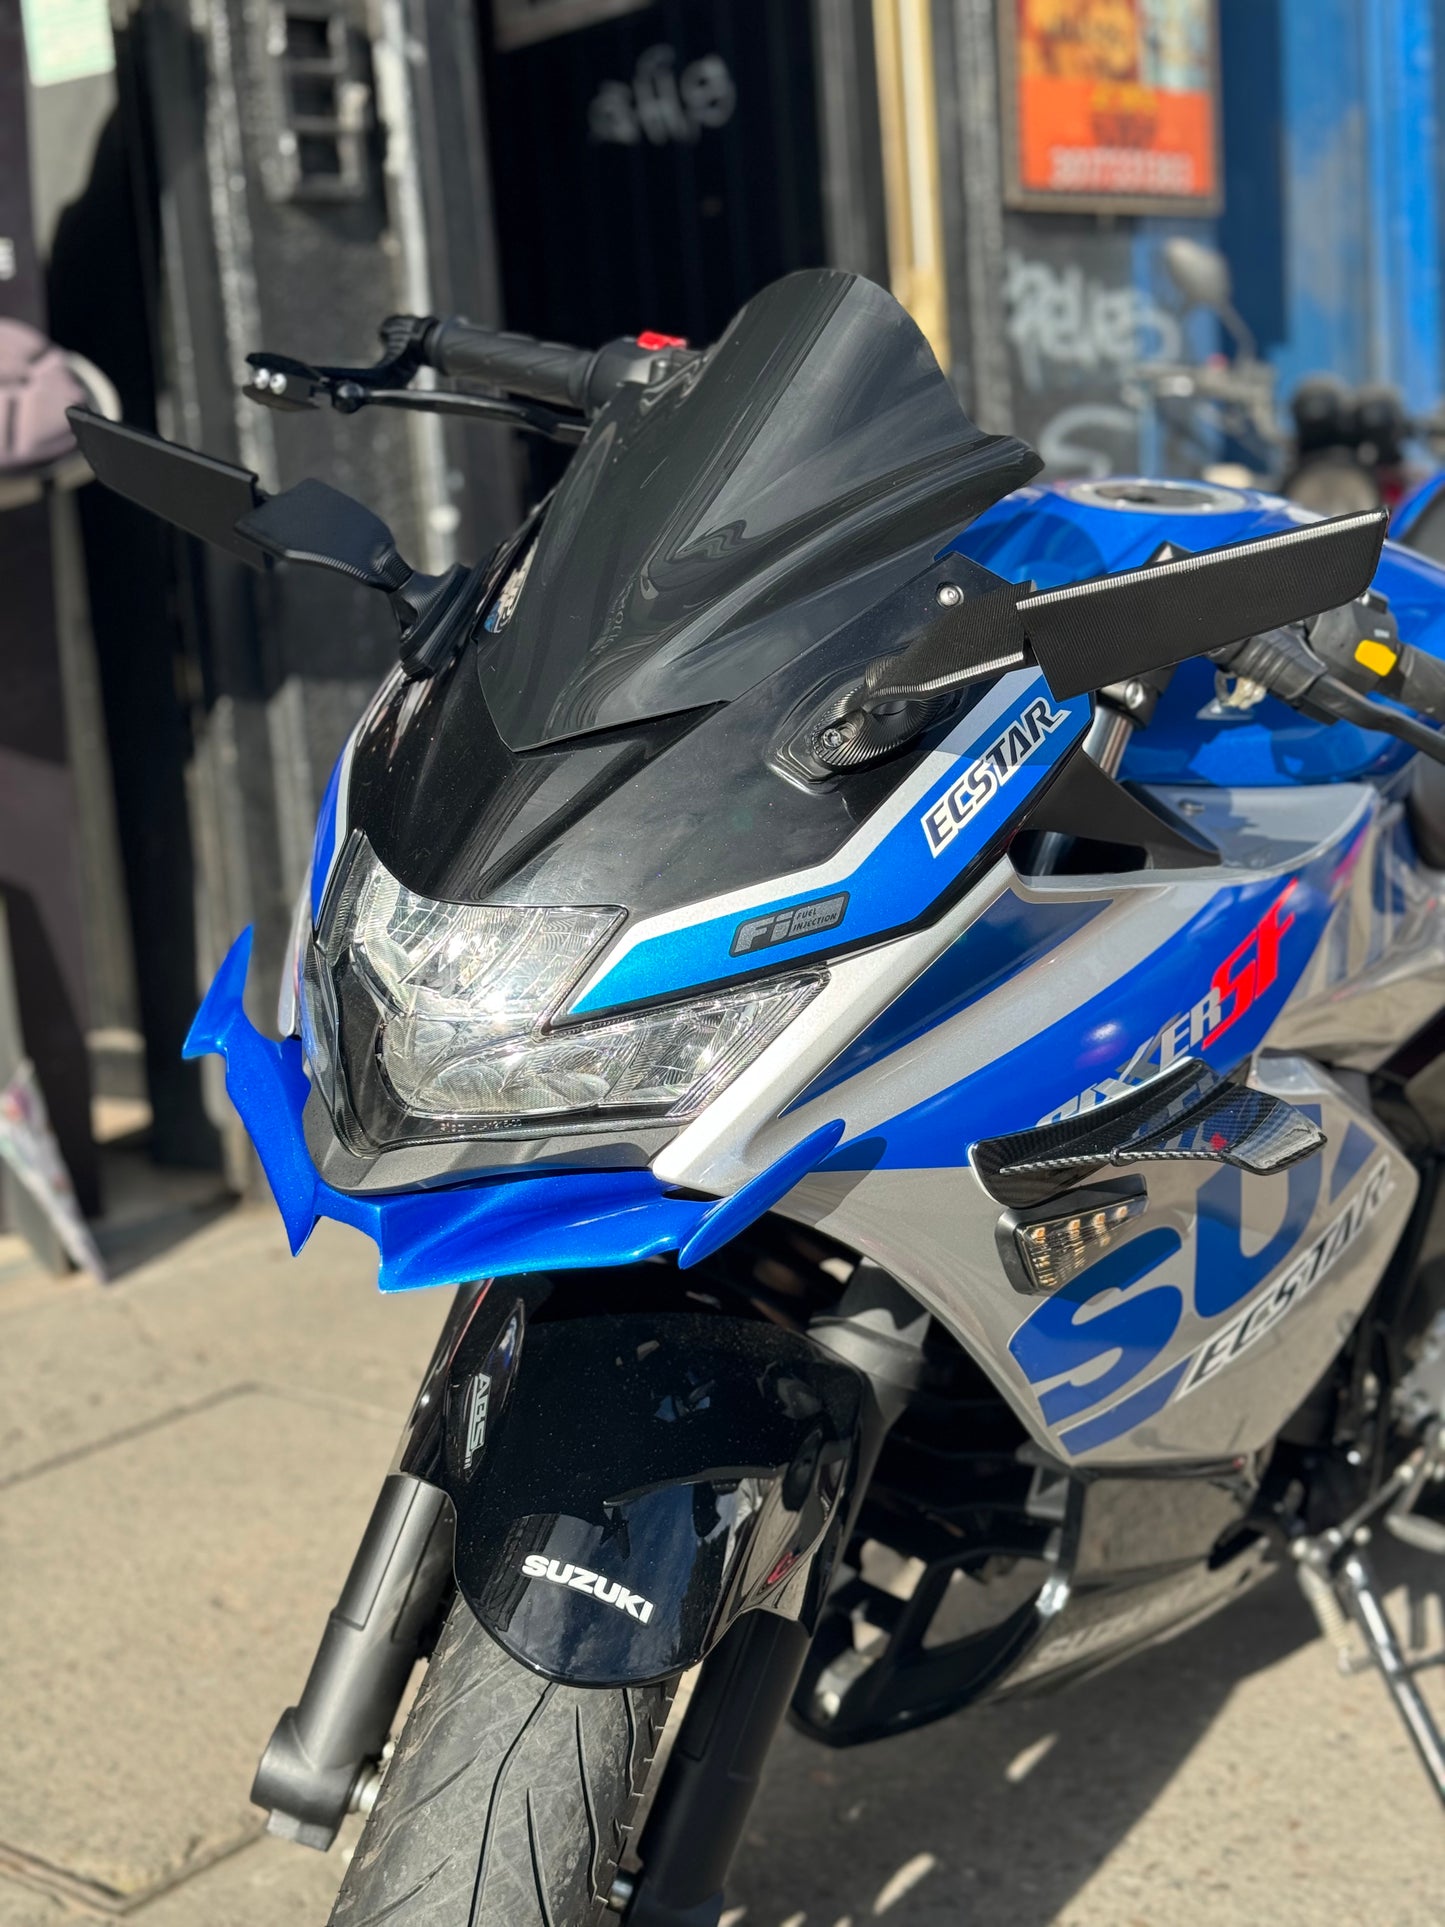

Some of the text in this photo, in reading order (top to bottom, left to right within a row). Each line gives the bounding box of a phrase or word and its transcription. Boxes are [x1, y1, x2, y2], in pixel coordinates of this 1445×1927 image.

[922, 699, 1069, 854] ECSTAR
[792, 912, 838, 932] INJECTION
[796, 907, 818, 921] FUEL
[1201, 877, 1298, 1051] SF
[1182, 1157, 1393, 1393] ECSTAR
[468, 1371, 493, 1453] ABS
[521, 1554, 654, 1624] SUZUKI
